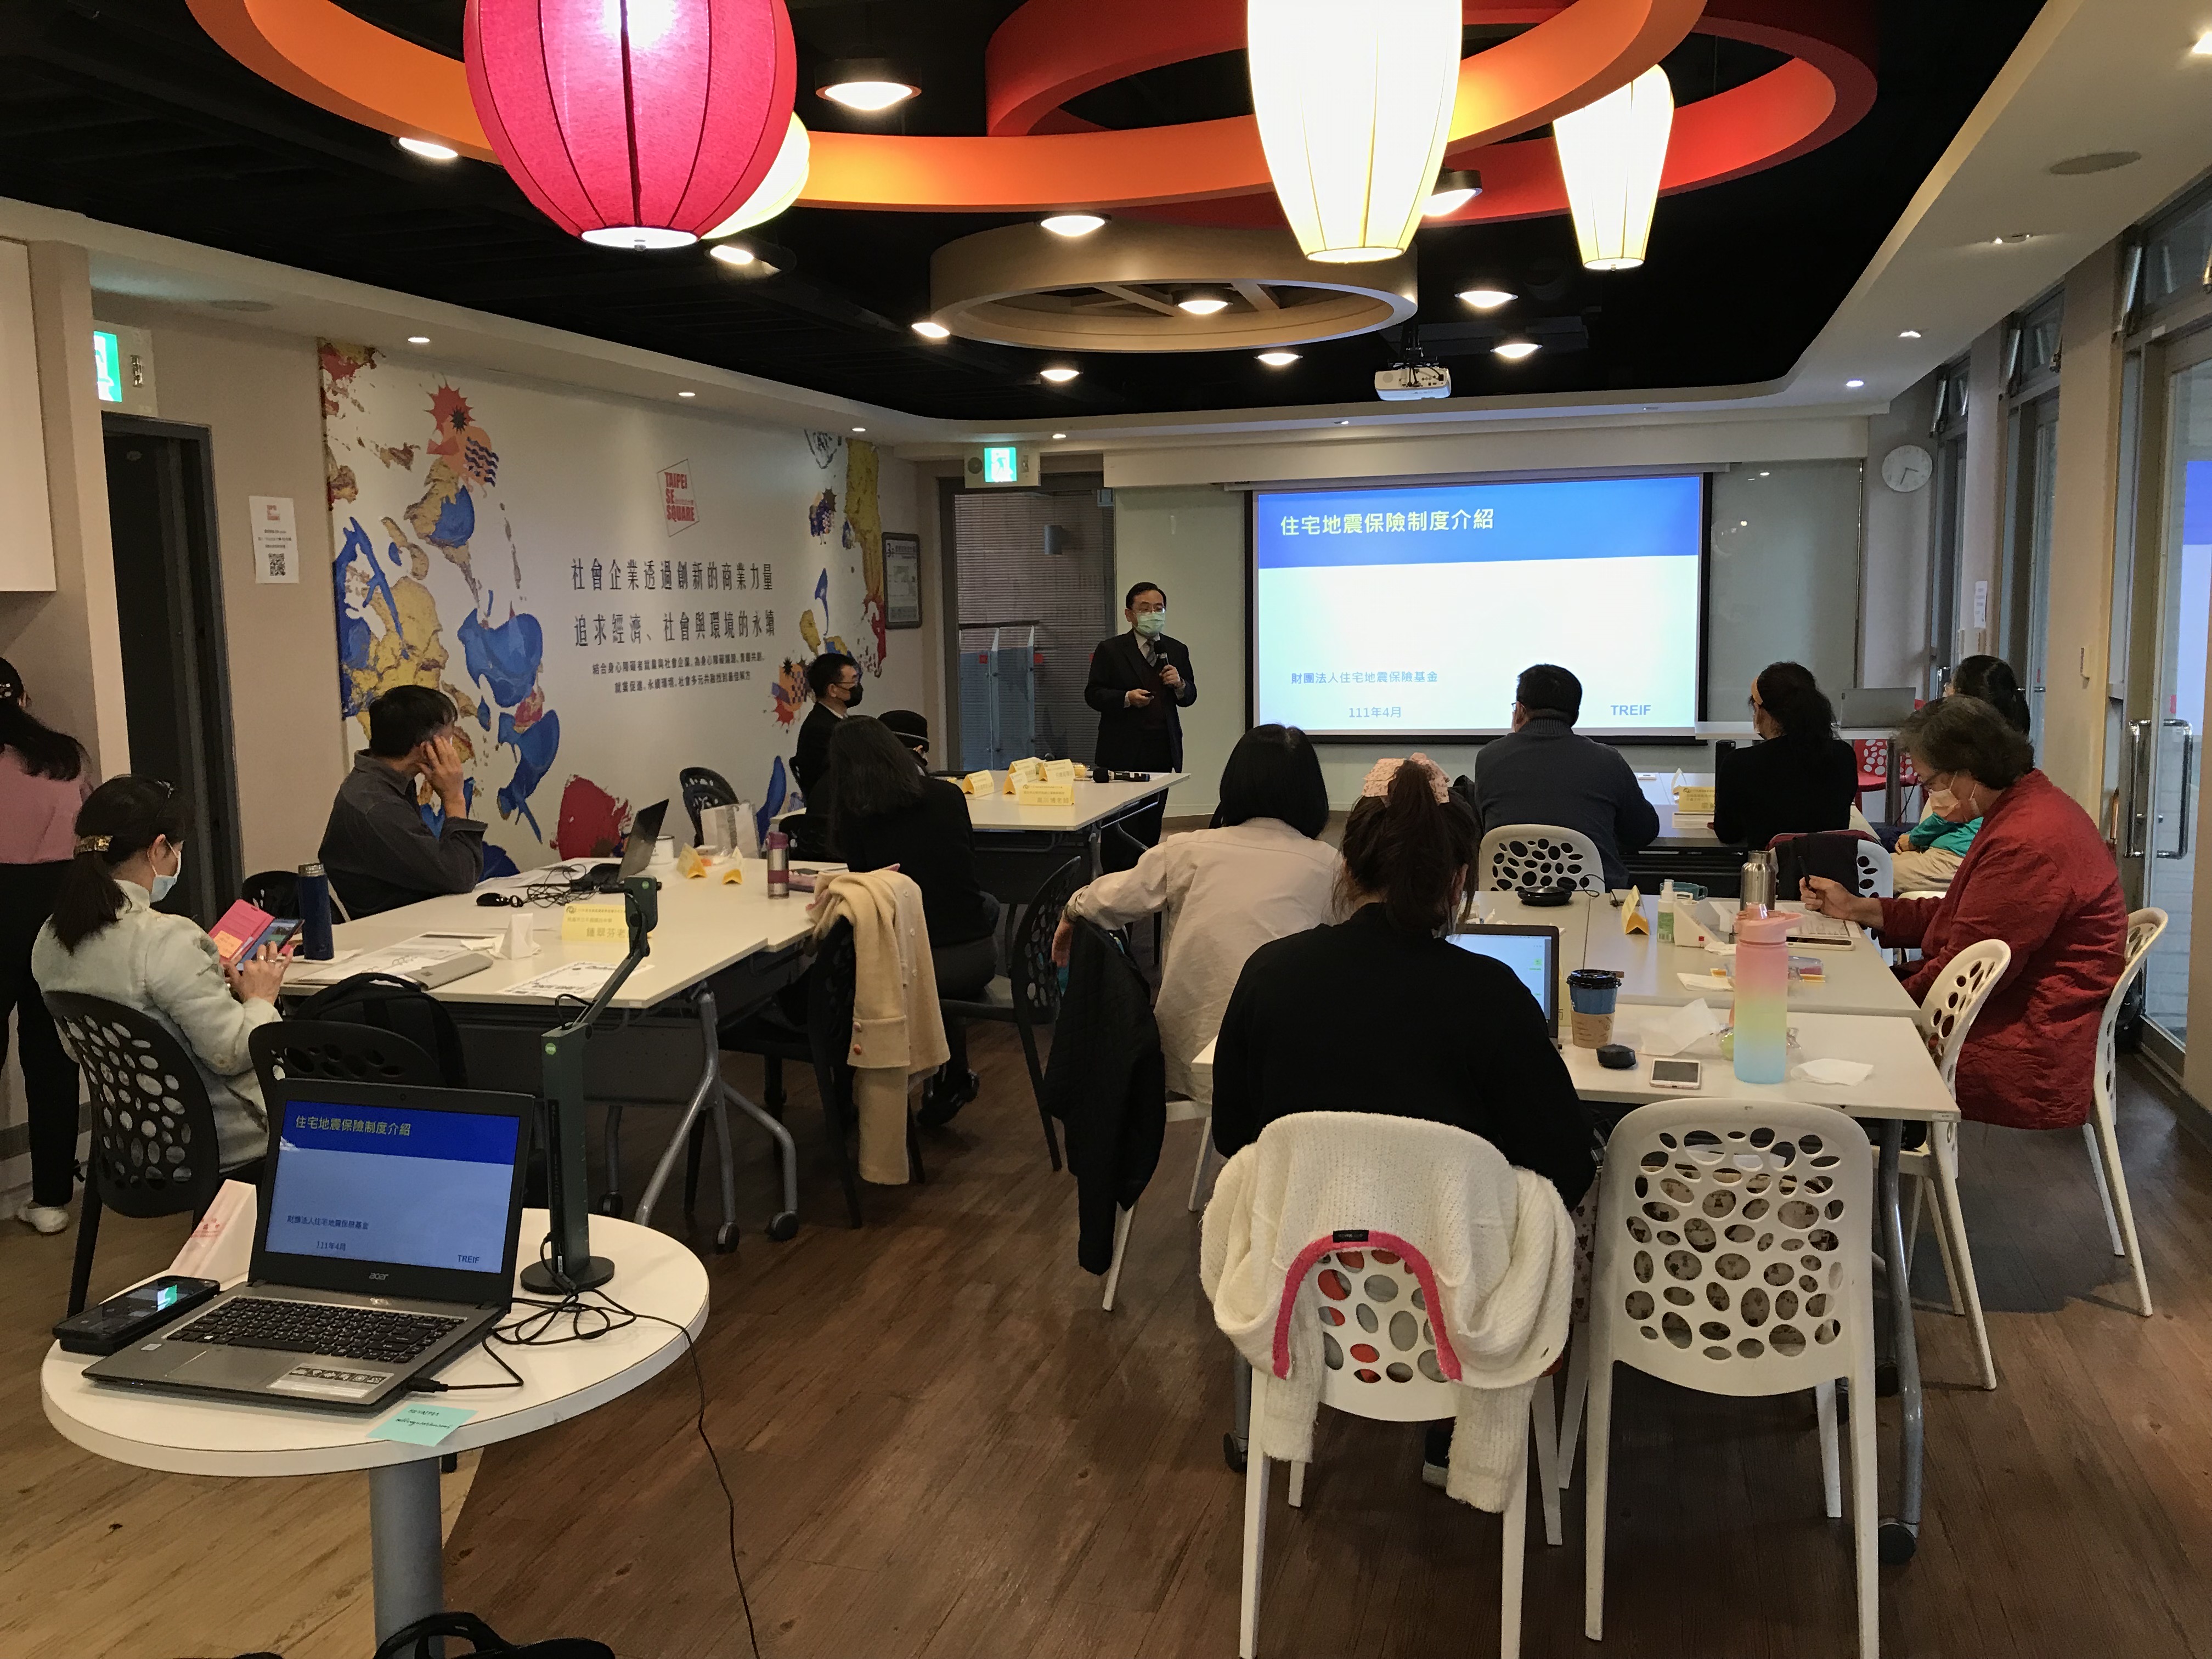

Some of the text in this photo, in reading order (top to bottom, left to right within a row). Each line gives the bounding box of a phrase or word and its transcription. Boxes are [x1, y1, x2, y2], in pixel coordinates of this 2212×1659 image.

[664, 472, 687, 489] TAIPEI
[665, 488, 674, 504] SE
[667, 505, 695, 522] SQUARE
[1280, 508, 1494, 535] 住宅地震保險制度介紹
[571, 558, 773, 590] 社會企業透過創新的商業力量
[1291, 670, 1438, 685] 財團法人住宅地震保險基金
[1348, 707, 1402, 719] 111年4月
[1610, 704, 1652, 716] TREIF
[295, 1115, 411, 1136] 住宅地震保險制度介紹
[317, 1240, 346, 1251] 111年4月
[458, 1254, 480, 1264] TREIF
[369, 1272, 389, 1280] acer
